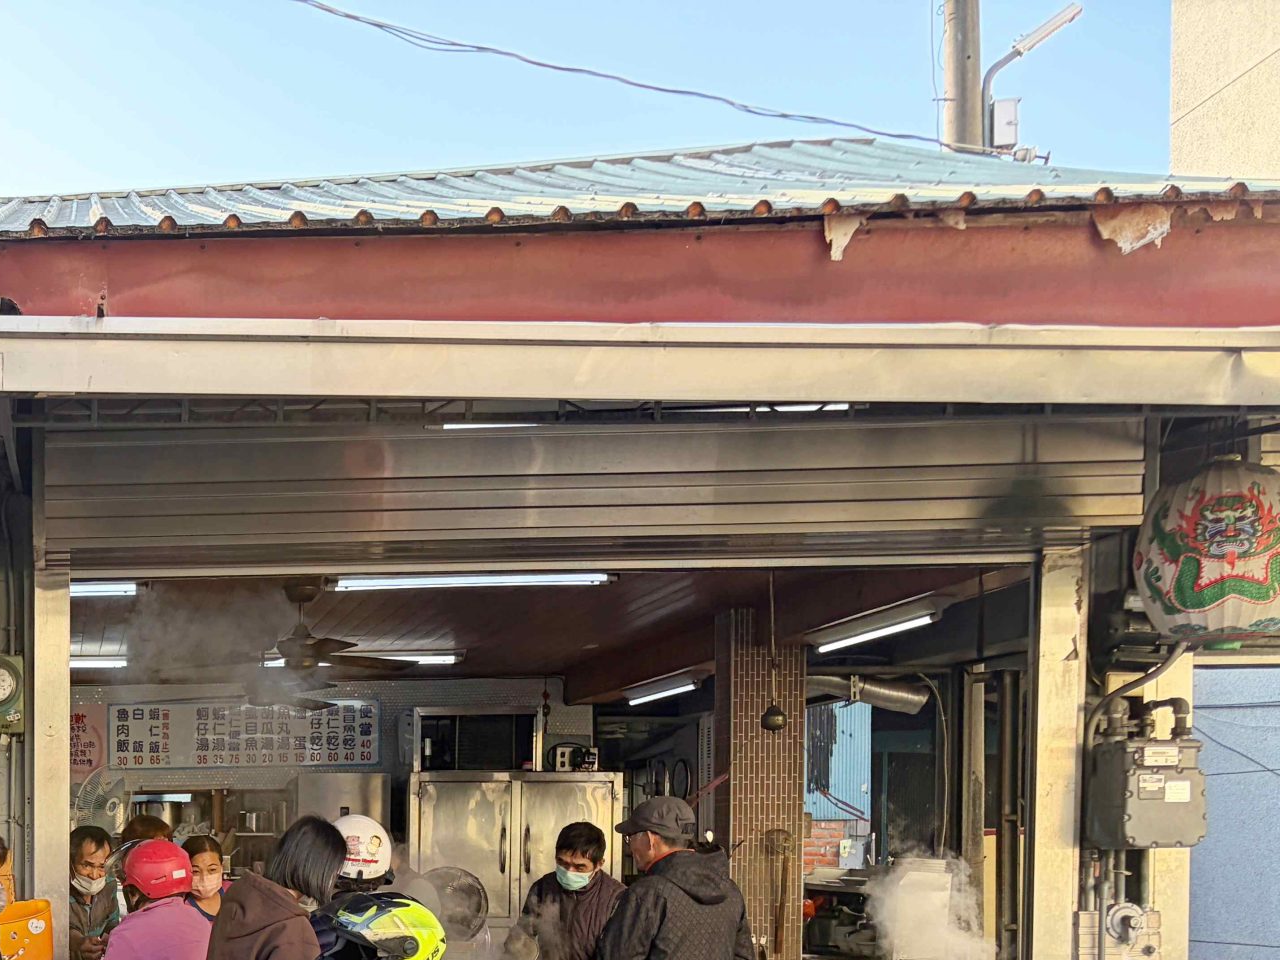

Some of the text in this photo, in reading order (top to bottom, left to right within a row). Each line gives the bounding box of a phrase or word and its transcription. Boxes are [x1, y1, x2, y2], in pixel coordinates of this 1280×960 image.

[359, 704, 373, 736] 便當
[116, 708, 130, 766] 魯肉飯 30
[132, 707, 144, 765] 白飯 10
[148, 708, 161, 765] 蝦仁飯 65
[212, 707, 225, 764] 蝦仁湯 35
[360, 739, 372, 750] 40
[229, 754, 240, 764] 75
[246, 753, 257, 764] 30
[262, 753, 273, 763] 20
[279, 753, 289, 763] 15
[294, 753, 305, 763] 15
[310, 752, 322, 762] 60
[327, 752, 339, 762] 60
[344, 751, 355, 762] 40
